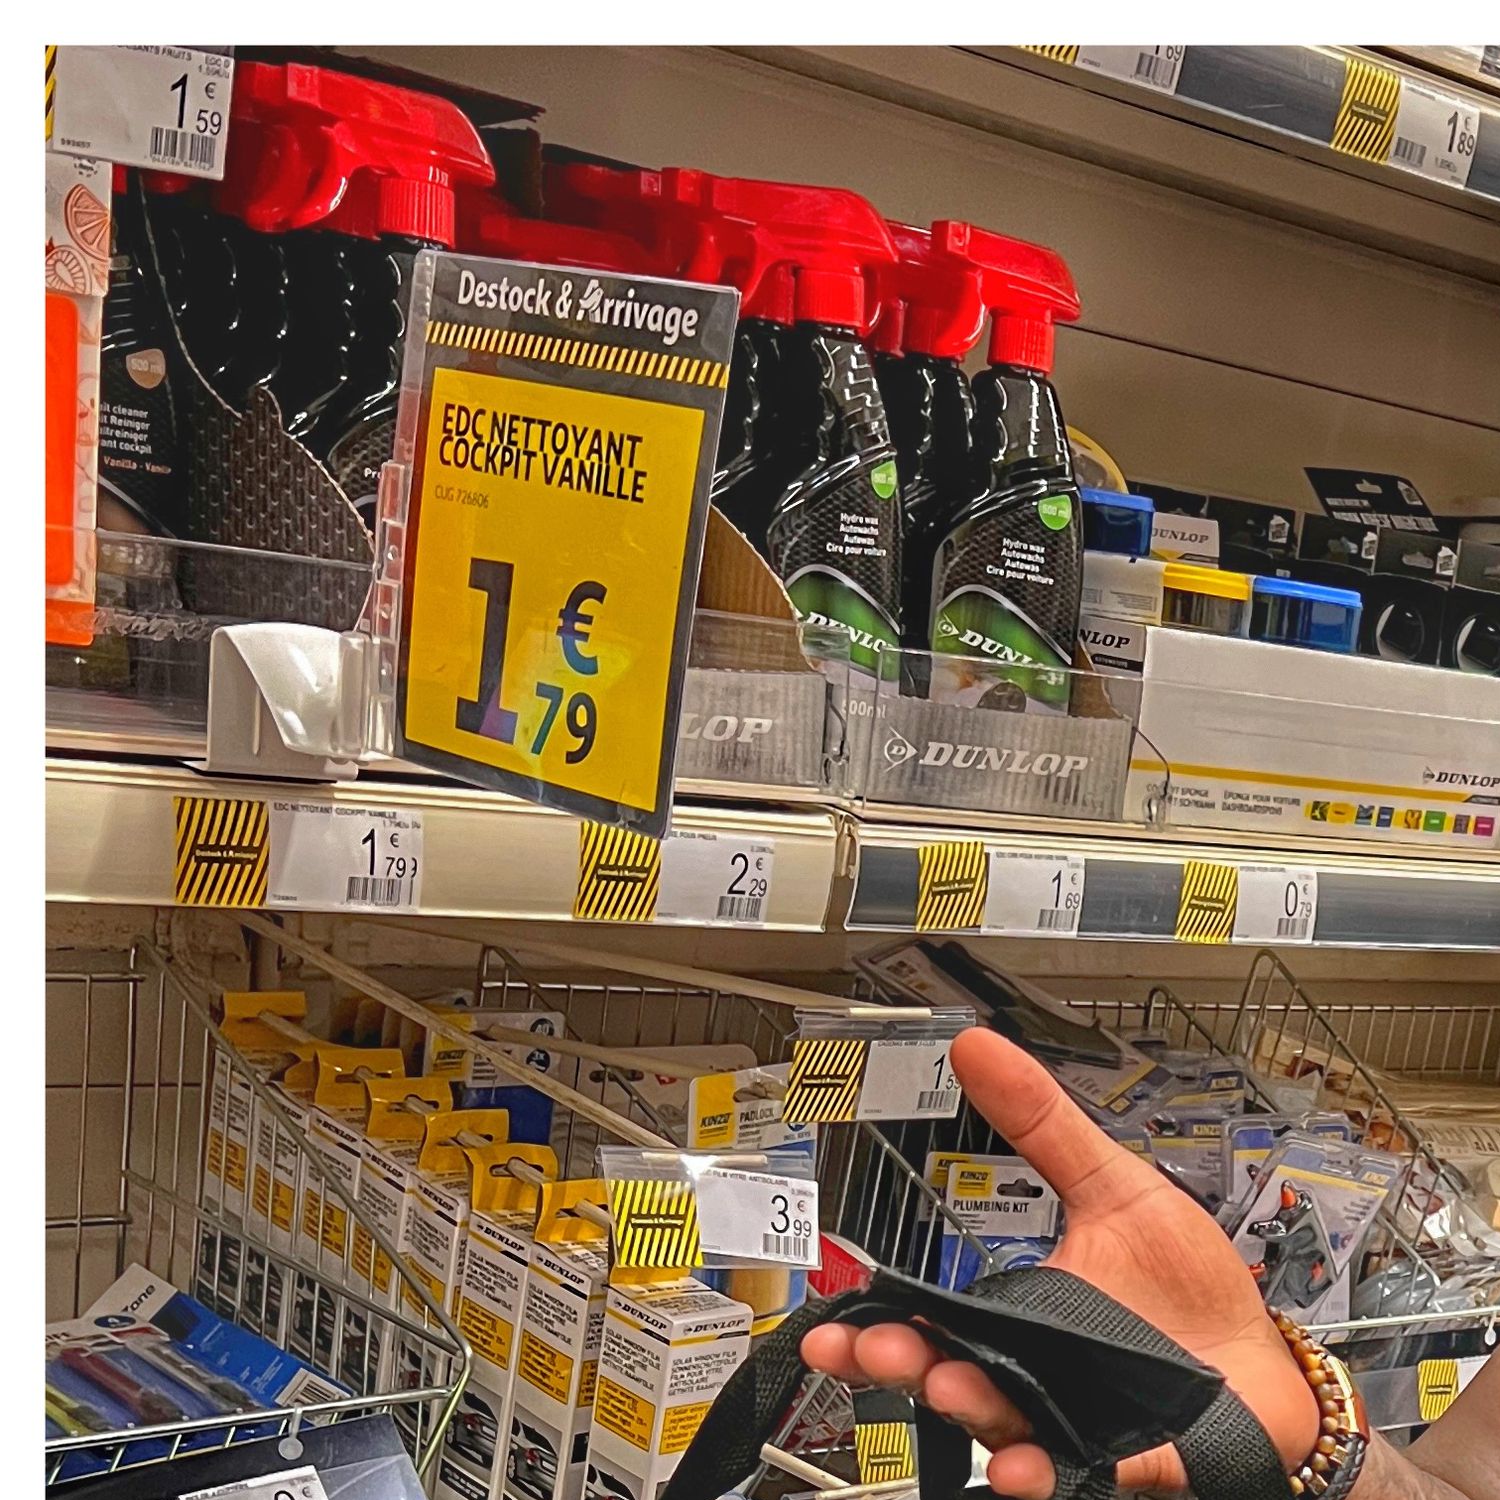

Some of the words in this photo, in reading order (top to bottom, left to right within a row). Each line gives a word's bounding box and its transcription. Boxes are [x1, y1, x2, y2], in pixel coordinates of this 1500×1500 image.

[170, 73, 188, 129] 1
[196, 109, 222, 135] 59
[1447, 111, 1459, 153] 1
[1457, 132, 1475, 156] 89
[457, 270, 552, 317] Destock
[555, 279, 573, 319] &
[576, 278, 699, 346] Arrivage
[442, 402, 486, 440] EDC
[490, 410, 643, 468] NETTOYANT
[439, 434, 537, 482] COCKPIT
[542, 453, 648, 504] VANILLE
[986, 564, 1005, 577] Cire
[556, 580, 608, 676] €
[455, 556, 518, 746] 1
[530, 681, 597, 765] 79
[919, 740, 1090, 779] DUNLOP
[361, 828, 377, 876] 1
[385, 856, 406, 878] 79
[727, 852, 749, 896] 2
[748, 878, 768, 898] 29
[1052, 870, 1063, 909] 1
[1065, 892, 1081, 910] 69
[1285, 880, 1299, 917] 0
[934, 1053, 946, 1090] 1
[771, 1194, 790, 1234] 3
[793, 1219, 812, 1238] 99
[952, 1199, 1010, 1213] PLUMBING
[1012, 1202, 1030, 1213] KIT
[484, 1226, 525, 1252] DUNLOP
[543, 1259, 585, 1286] DUNLOP
[621, 1303, 668, 1331] DUNLOP
[692, 1319, 746, 1333] DUNLOP
